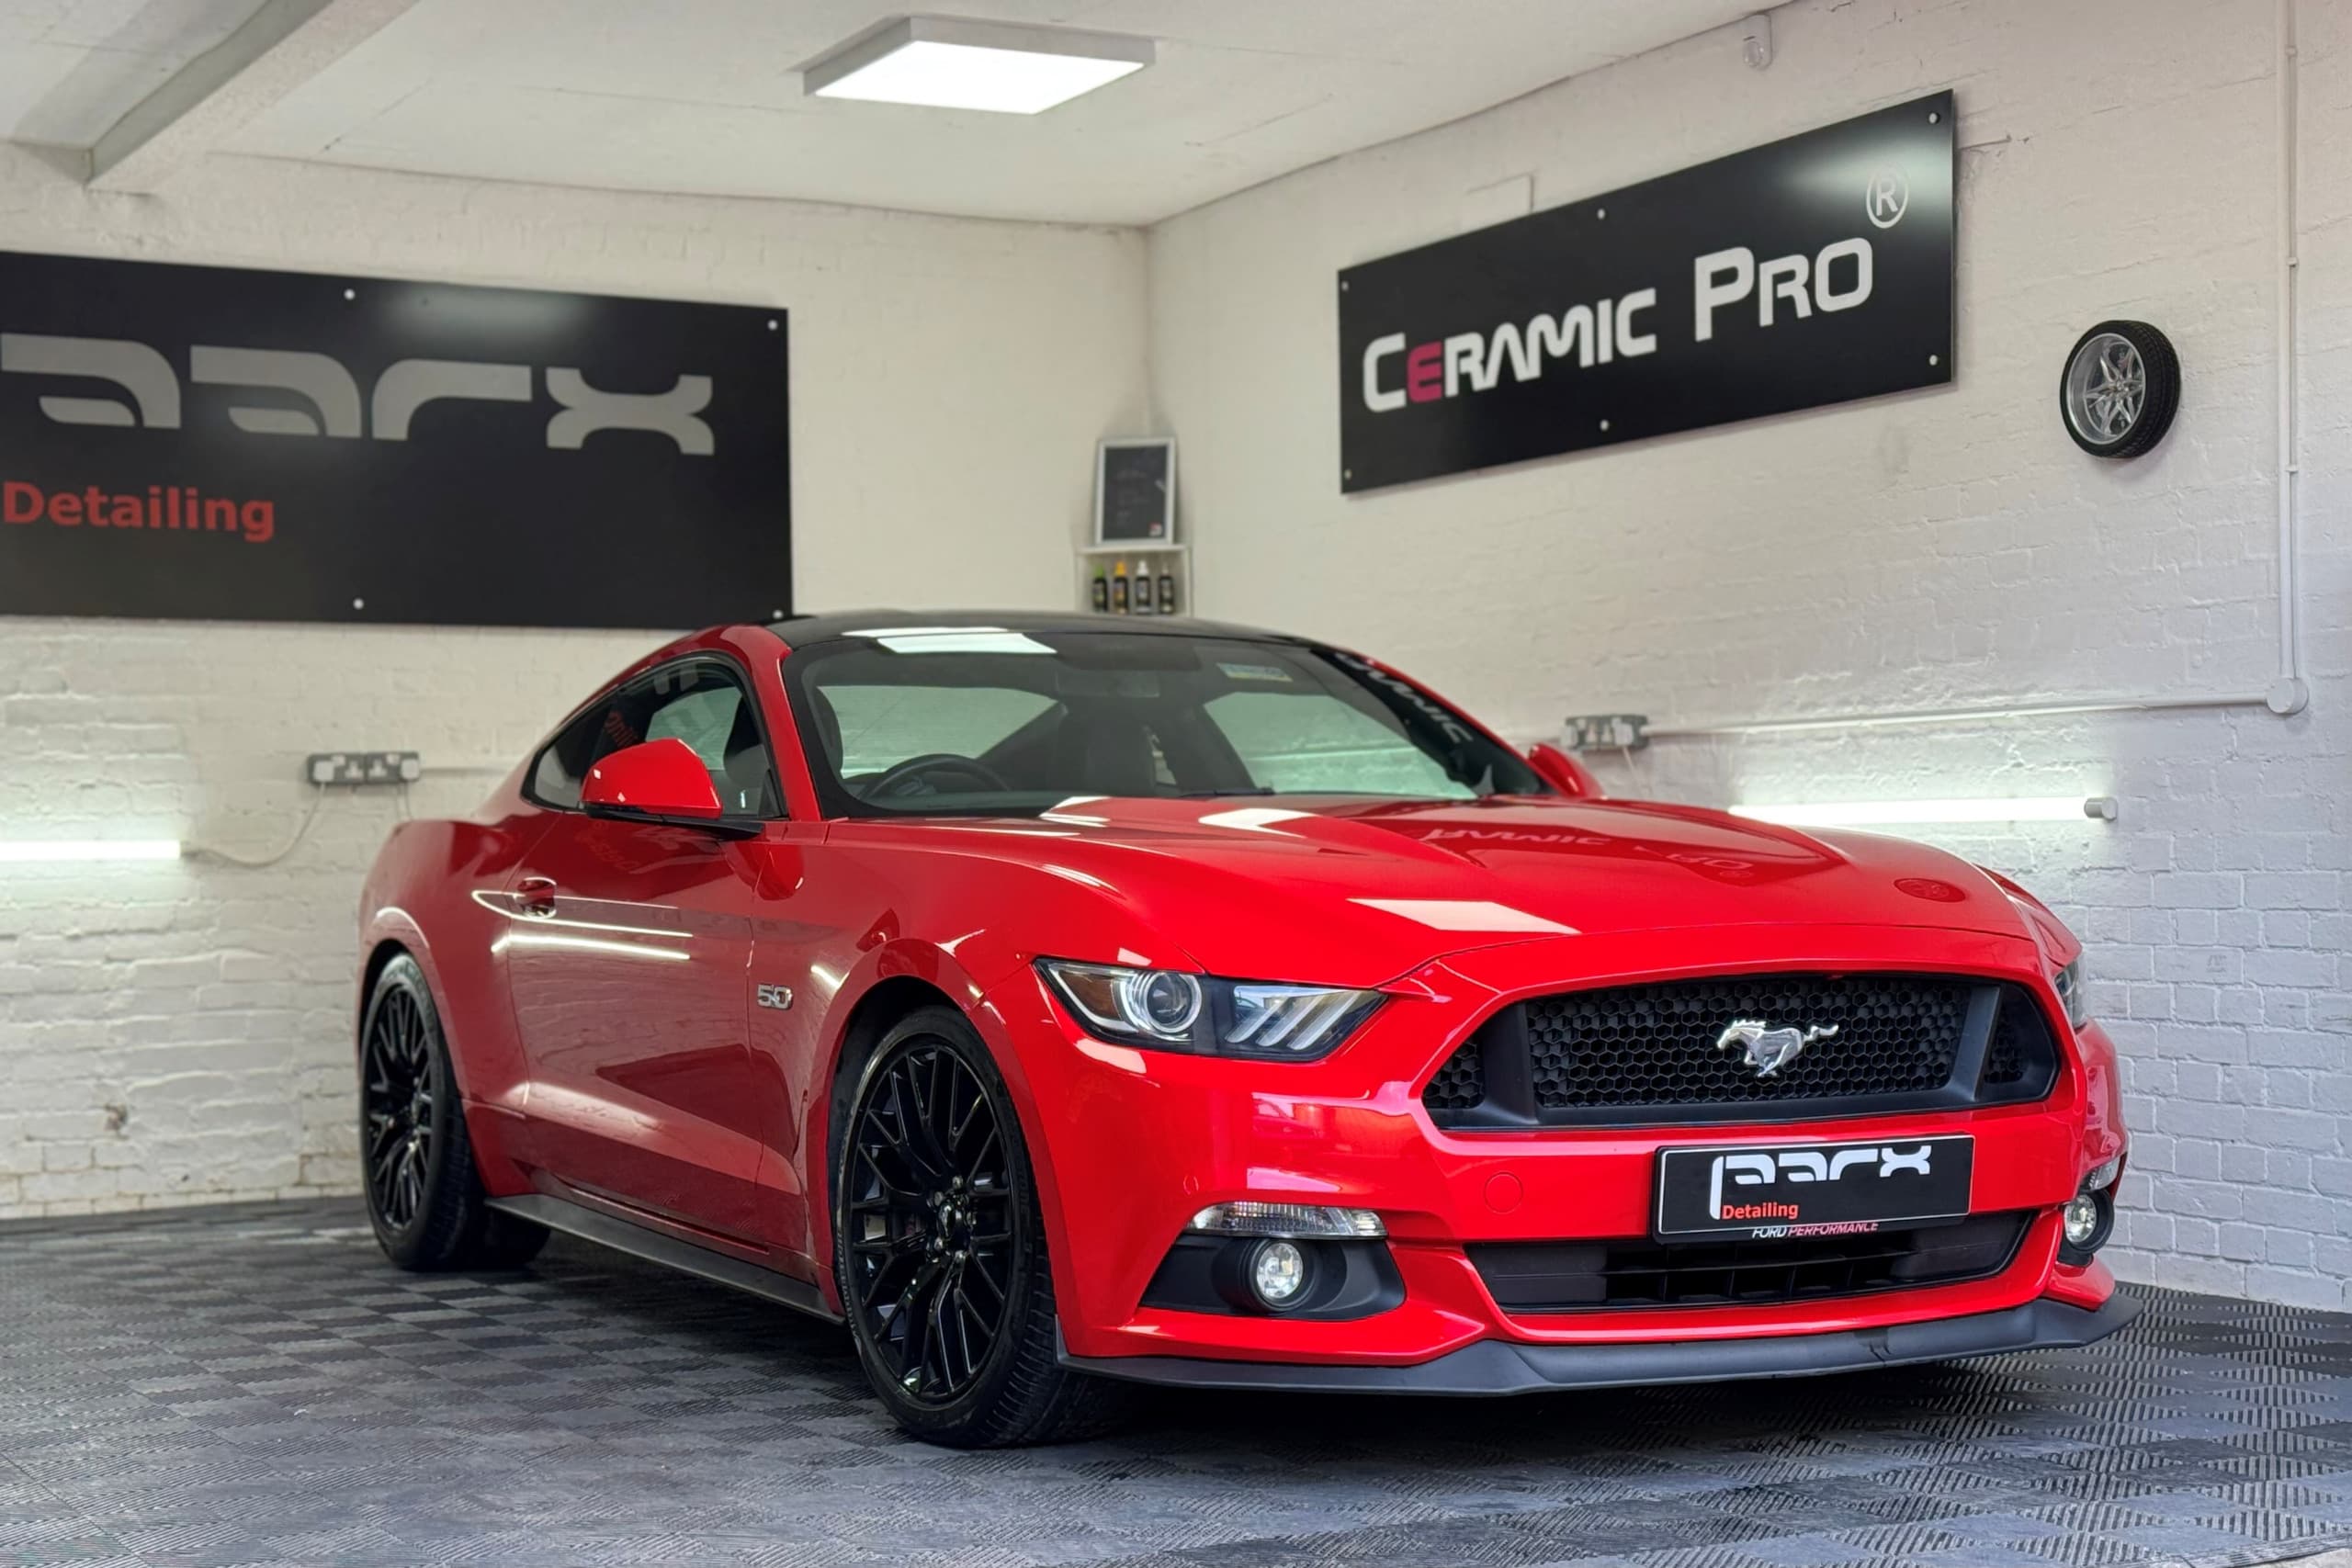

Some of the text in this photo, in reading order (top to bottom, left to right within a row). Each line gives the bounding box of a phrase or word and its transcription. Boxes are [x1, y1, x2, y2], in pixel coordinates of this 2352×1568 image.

[3, 480, 275, 543] Detailing
[1722, 1201, 1799, 1220] Detailing
[1751, 1223, 1880, 1239] FORD PERFORMANCE
